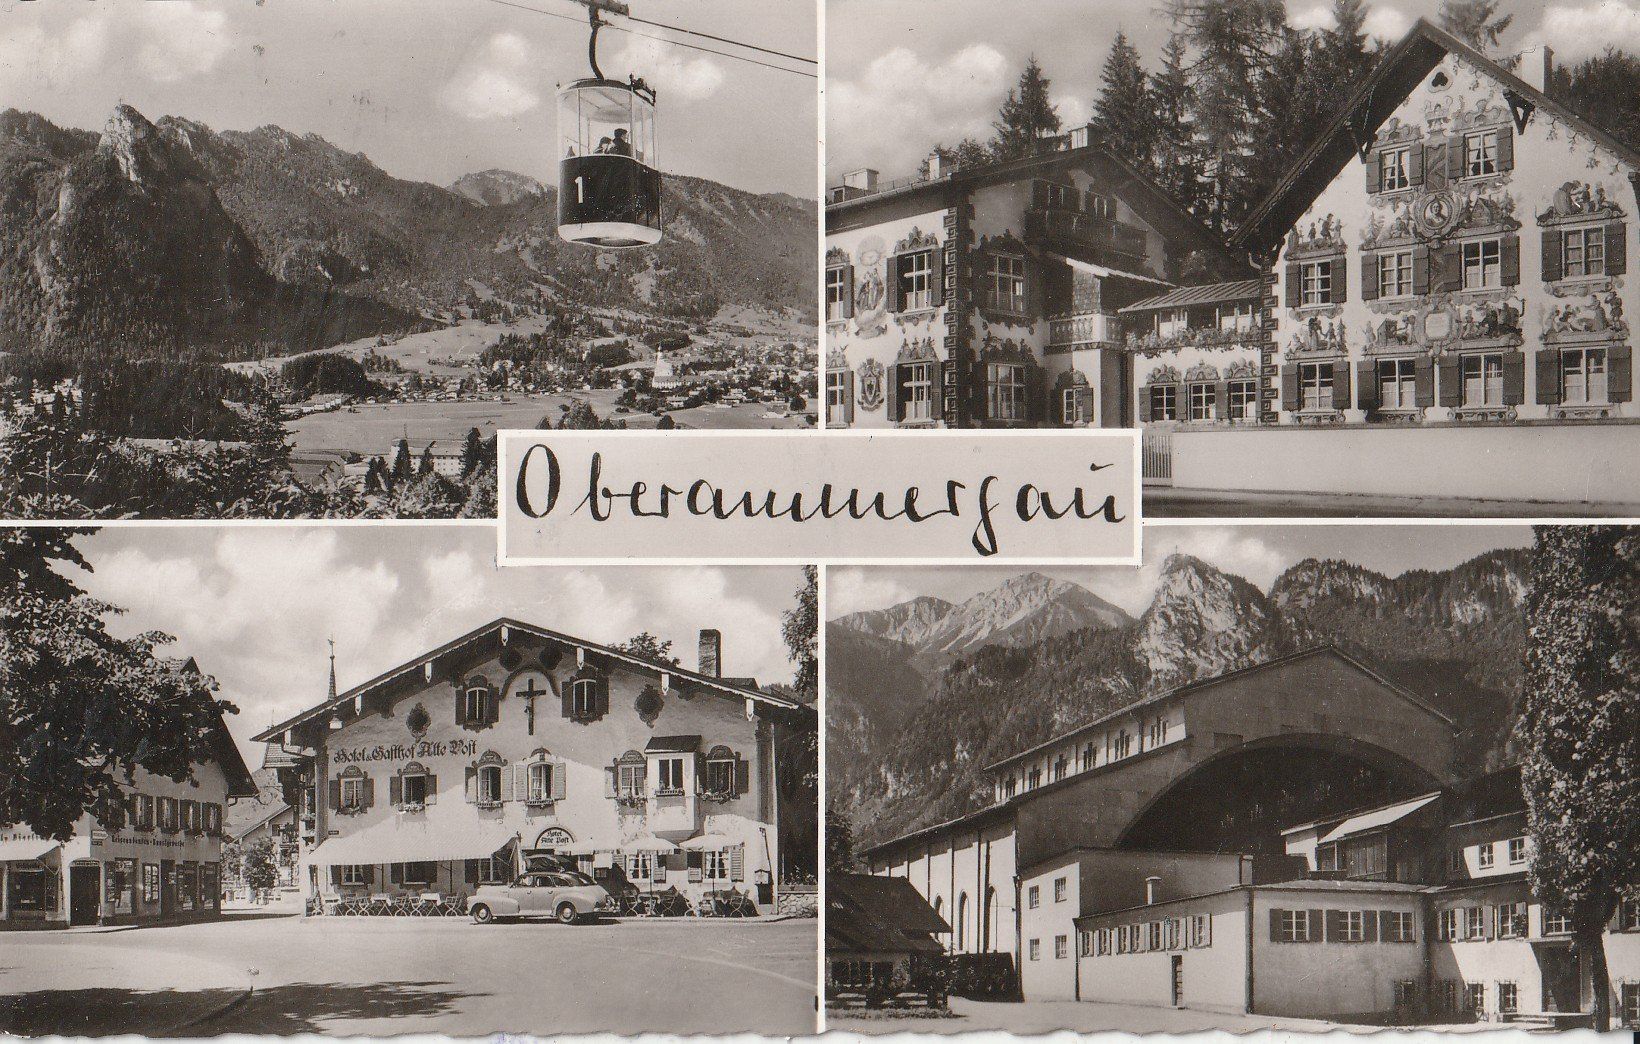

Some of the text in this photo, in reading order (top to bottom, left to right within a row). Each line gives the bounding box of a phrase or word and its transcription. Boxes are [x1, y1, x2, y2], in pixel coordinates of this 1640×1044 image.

[574, 176, 584, 204] 1
[333, 747, 366, 763] Hotel
[372, 744, 416, 761] Gasthof
[416, 741, 446, 757] Alte
[448, 739, 476, 756] Post
